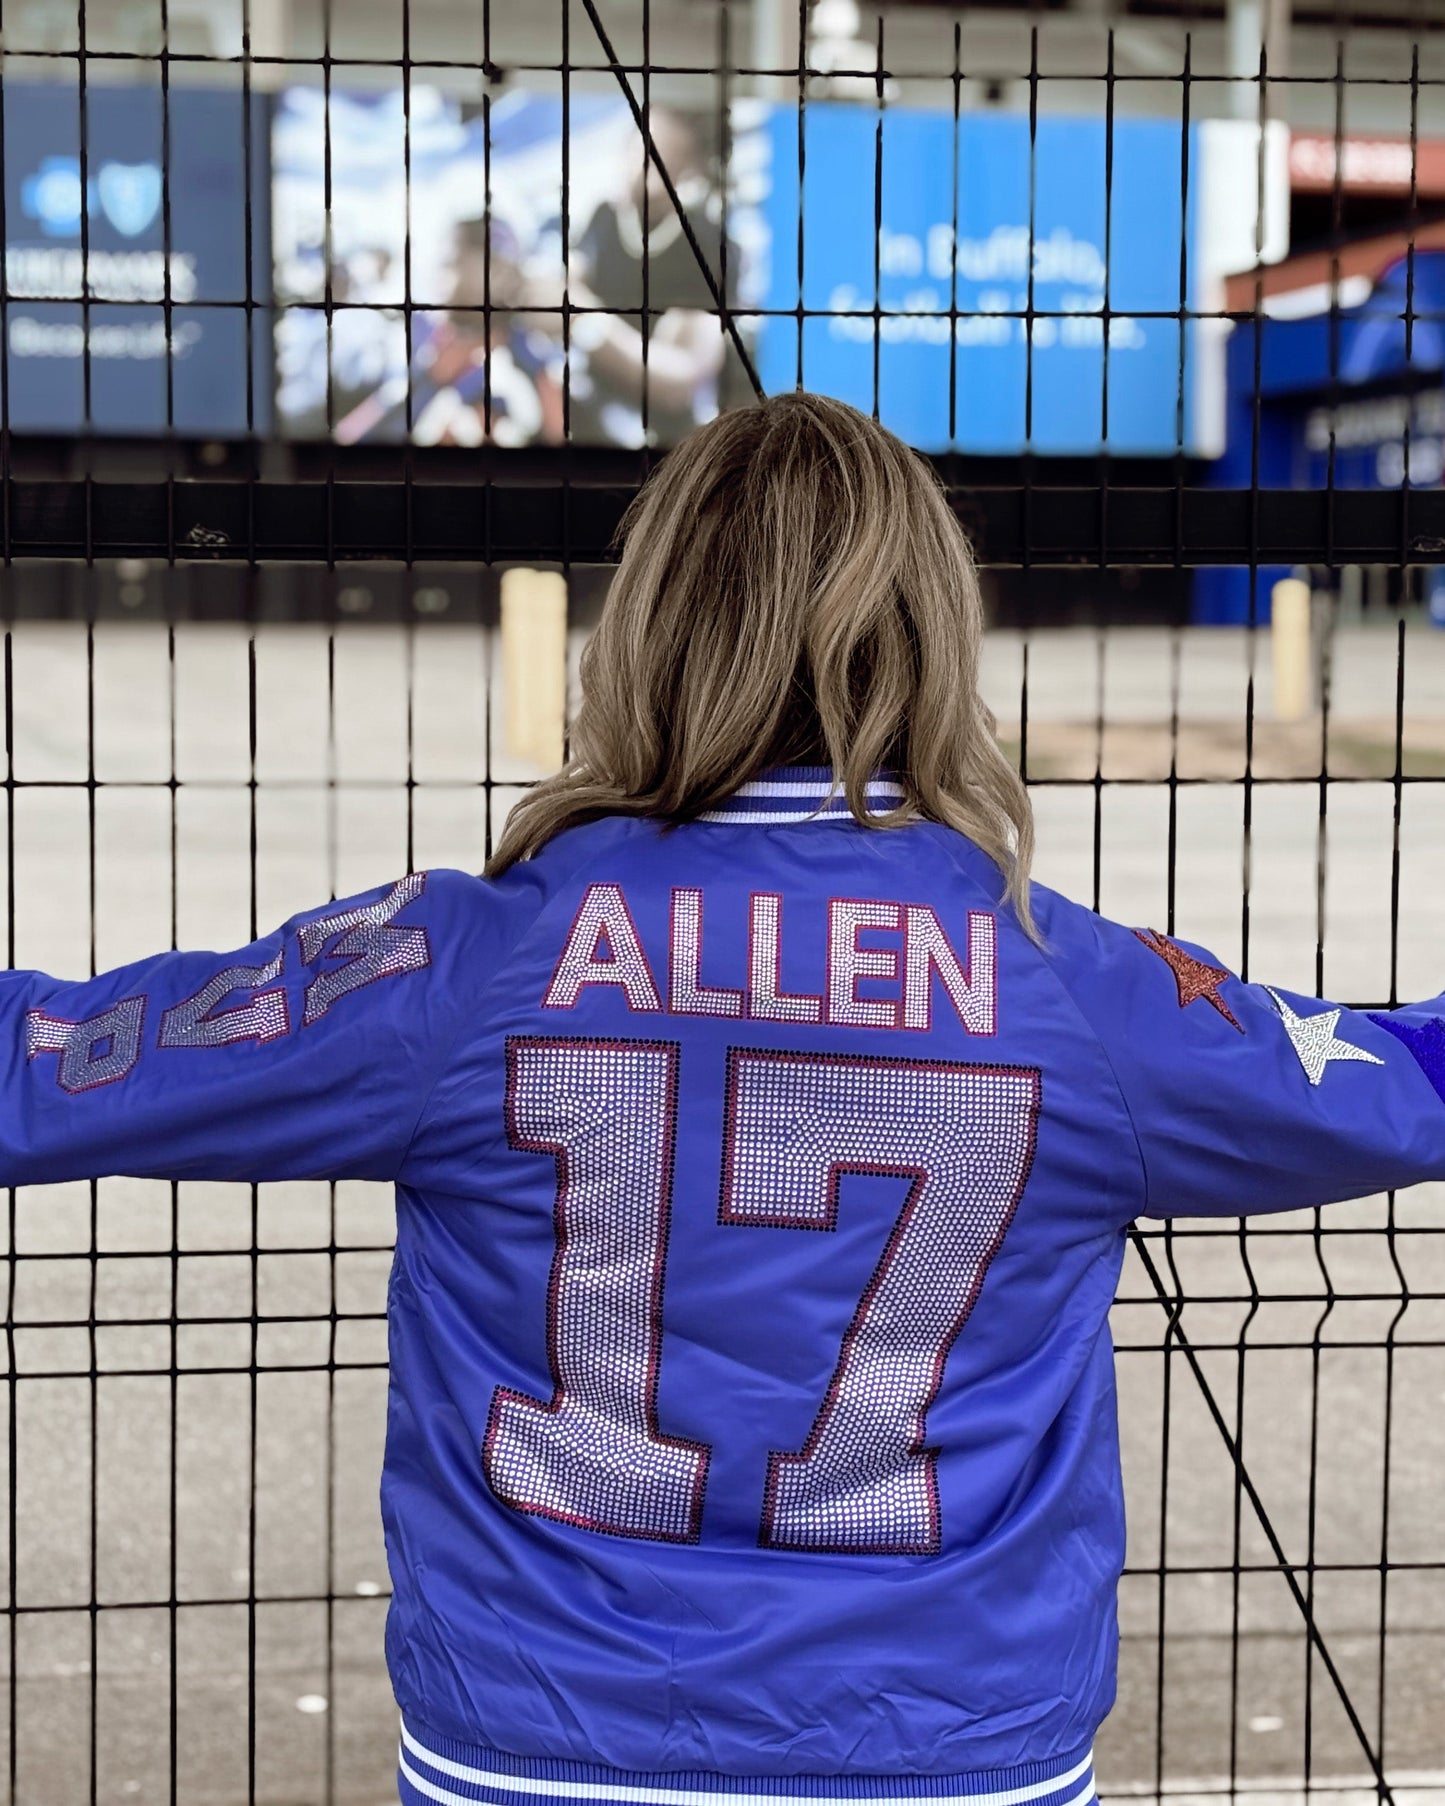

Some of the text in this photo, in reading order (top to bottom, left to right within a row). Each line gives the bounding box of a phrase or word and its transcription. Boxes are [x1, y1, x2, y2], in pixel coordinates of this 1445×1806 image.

[27, 871, 431, 1095] MVP
[541, 882, 997, 1037] ALLEN
[483, 1036, 1042, 1557] 17
